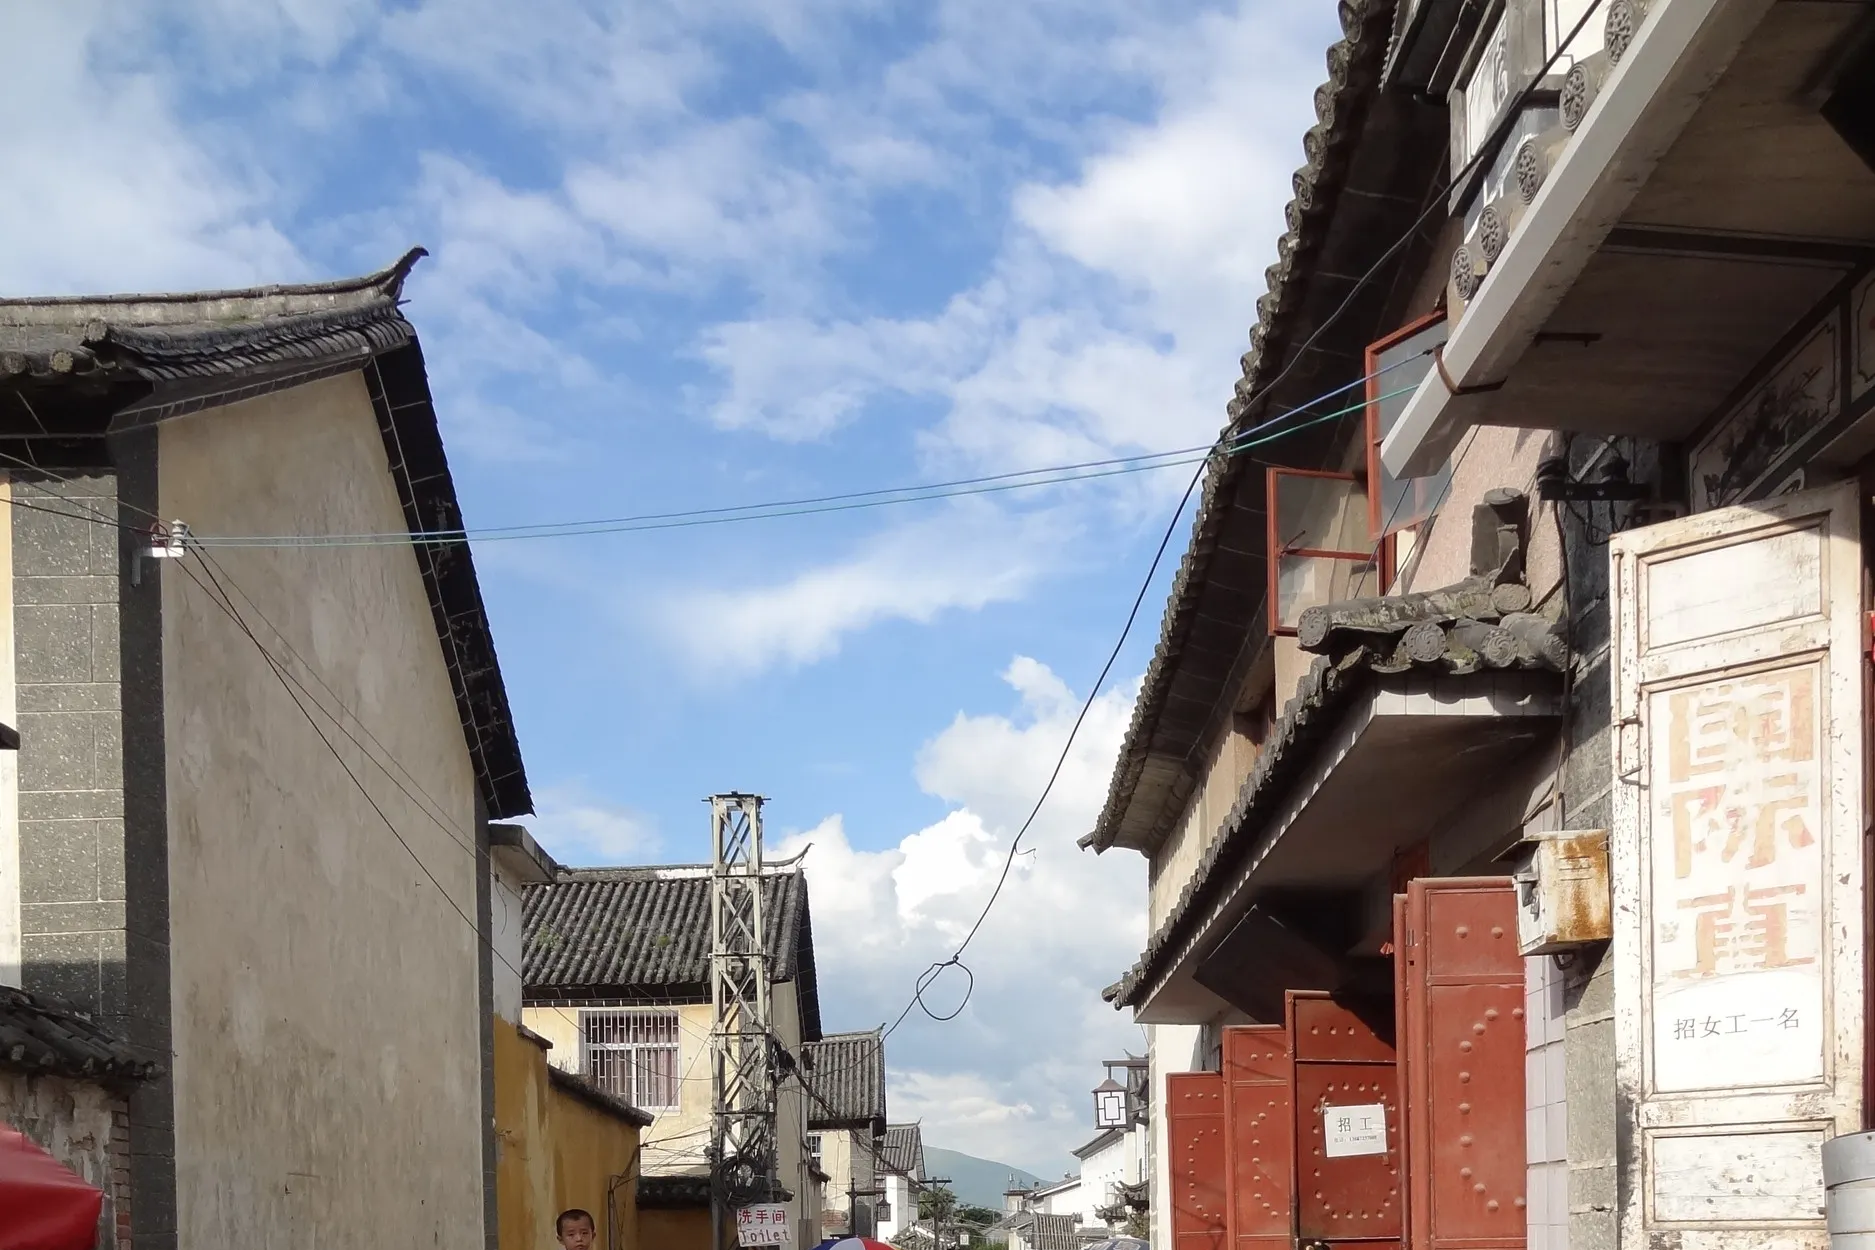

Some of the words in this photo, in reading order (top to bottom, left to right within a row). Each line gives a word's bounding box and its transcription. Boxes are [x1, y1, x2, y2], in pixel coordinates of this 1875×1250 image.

[1674, 1007, 1799, 1040] 招女工一名
[1337, 1117, 1372, 1132] 招工
[738, 1209, 785, 1224] 洗手间
[741, 1229, 791, 1244] Toilet
